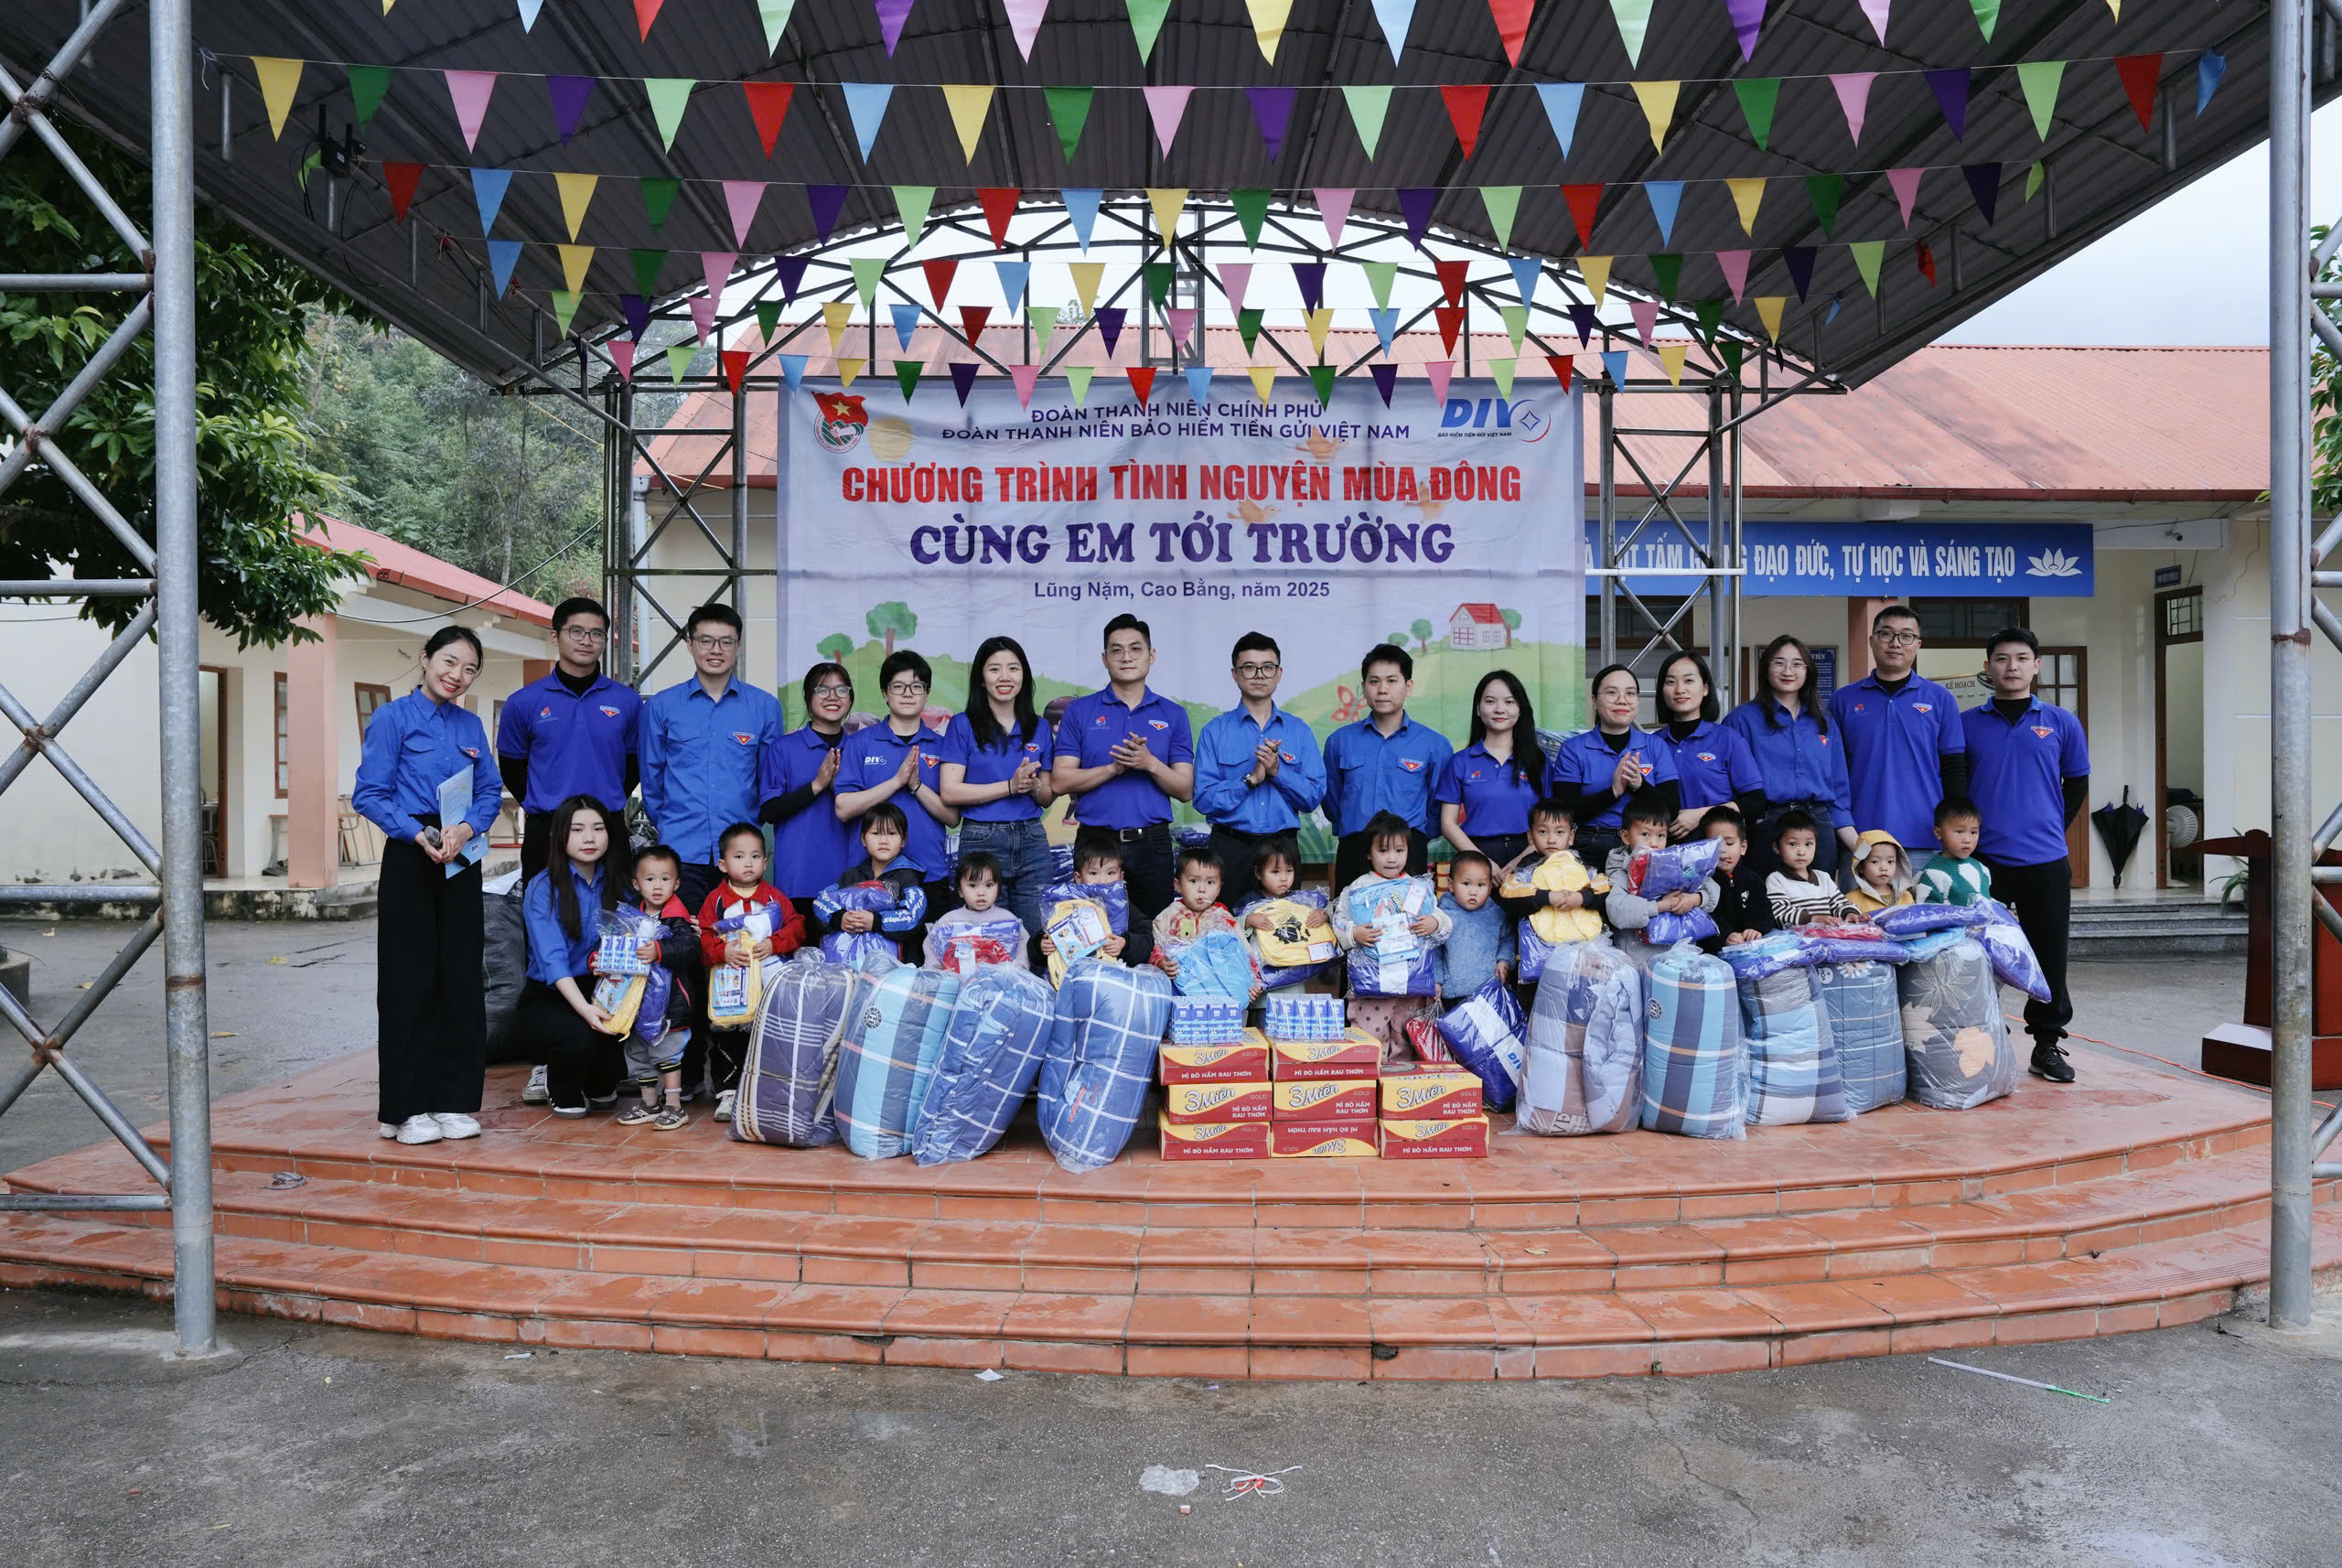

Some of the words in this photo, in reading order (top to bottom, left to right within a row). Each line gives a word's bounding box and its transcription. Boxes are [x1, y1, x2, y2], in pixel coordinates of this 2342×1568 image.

[1031, 407, 1087, 423] ĐOÀN
[1094, 403, 1160, 418] THANH
[1166, 399, 1210, 416] NIÊN
[1219, 401, 1276, 417] CHÍNH
[1284, 400, 1322, 417] PHỦ
[942, 427, 998, 439] ĐOÀN
[1005, 426, 1071, 439] THANH
[1080, 421, 1123, 437] NIÊN
[1131, 420, 1171, 436] BẢO
[1178, 417, 1223, 436] HIỂM
[1230, 419, 1273, 437] TIỀN
[1280, 420, 1311, 437] GỬI
[1319, 421, 1360, 442] VIỆT
[1368, 425, 1409, 438] NAM
[842, 462, 983, 503] CHƯƠNG
[994, 461, 1097, 502] TRÌNH
[1109, 458, 1187, 500] TÌNH
[1200, 459, 1330, 508] NGUYỆN
[1343, 460, 1418, 502] MÙA
[1429, 459, 1521, 502] ĐÔNG
[910, 513, 1050, 564] CÙNG
[1066, 521, 1134, 563] EM
[1149, 510, 1232, 563] TỚI
[1246, 510, 1455, 564] TRƯỜNG
[1754, 544, 1789, 583] ĐẠO
[1795, 539, 1834, 580] ĐỨC,
[1842, 543, 1865, 583] TỰ
[1871, 545, 1904, 583] HỌC
[1909, 540, 1929, 576] VÀ
[1935, 540, 1981, 577] SÁNG
[1985, 546, 2015, 583] TẠO
[1035, 582, 1081, 600] Lũng
[1088, 582, 1135, 600] Nặm,
[1141, 582, 1177, 596] Cao
[1184, 578, 1235, 600] Bằng,
[1242, 581, 1281, 596] năm
[1286, 582, 1330, 596] 2025
